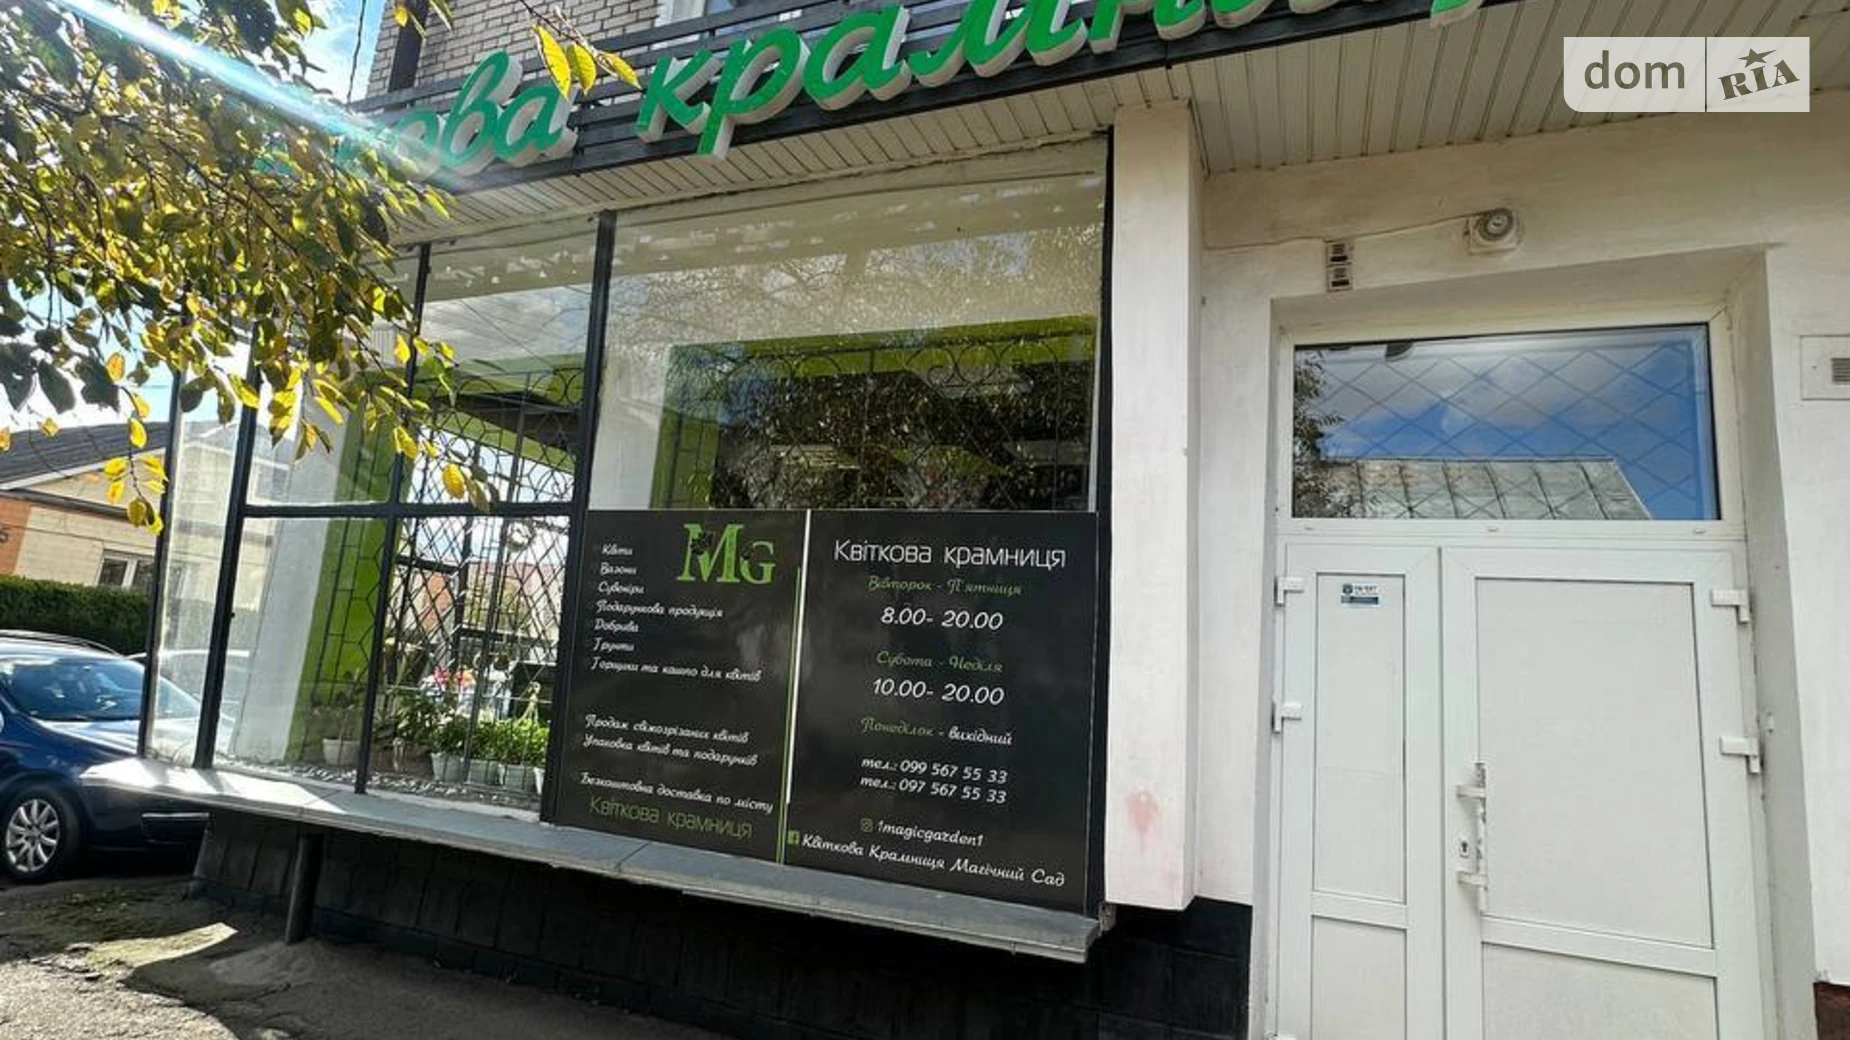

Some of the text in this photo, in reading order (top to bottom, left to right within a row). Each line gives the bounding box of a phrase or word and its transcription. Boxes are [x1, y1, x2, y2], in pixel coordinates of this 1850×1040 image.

[676, 522, 776, 585] MG
[834, 538, 1067, 572] Квіткова крамниця
[600, 561, 637, 576] Вазони
[598, 580, 645, 596] Сувеніри
[867, 574, 933, 593] Вівторок
[596, 599, 724, 620] Подарункова продукція
[881, 606, 1004, 631] 8.00- 20.00
[594, 617, 640, 634] Добрива
[590, 656, 762, 682] Горщики та кашпо для квітів
[876, 650, 933, 669] Субота
[948, 655, 1004, 674] Неділя
[872, 677, 1006, 706] 10.00- 20.00
[585, 714, 750, 744] Продаж свіжозрізаних квітів
[860, 716, 934, 737] Понеділок
[948, 725, 1013, 746] вихідний
[583, 733, 759, 768] Упаковка квітів та подарунків
[899, 759, 928, 775] 099
[930, 763, 959, 778] 567
[962, 766, 983, 782] 55
[987, 769, 1008, 785] 33
[580, 771, 775, 815] Безкоштовна доставка по місту
[899, 778, 926, 793] 097
[930, 781, 958, 797] 567
[961, 785, 982, 800] 55
[986, 789, 1008, 804] 33
[589, 796, 753, 840] Квіткова крамниця
[877, 819, 984, 847] 1magicgarden1
[801, 833, 1066, 887] Квіткова Крамниця Магічний Сад
